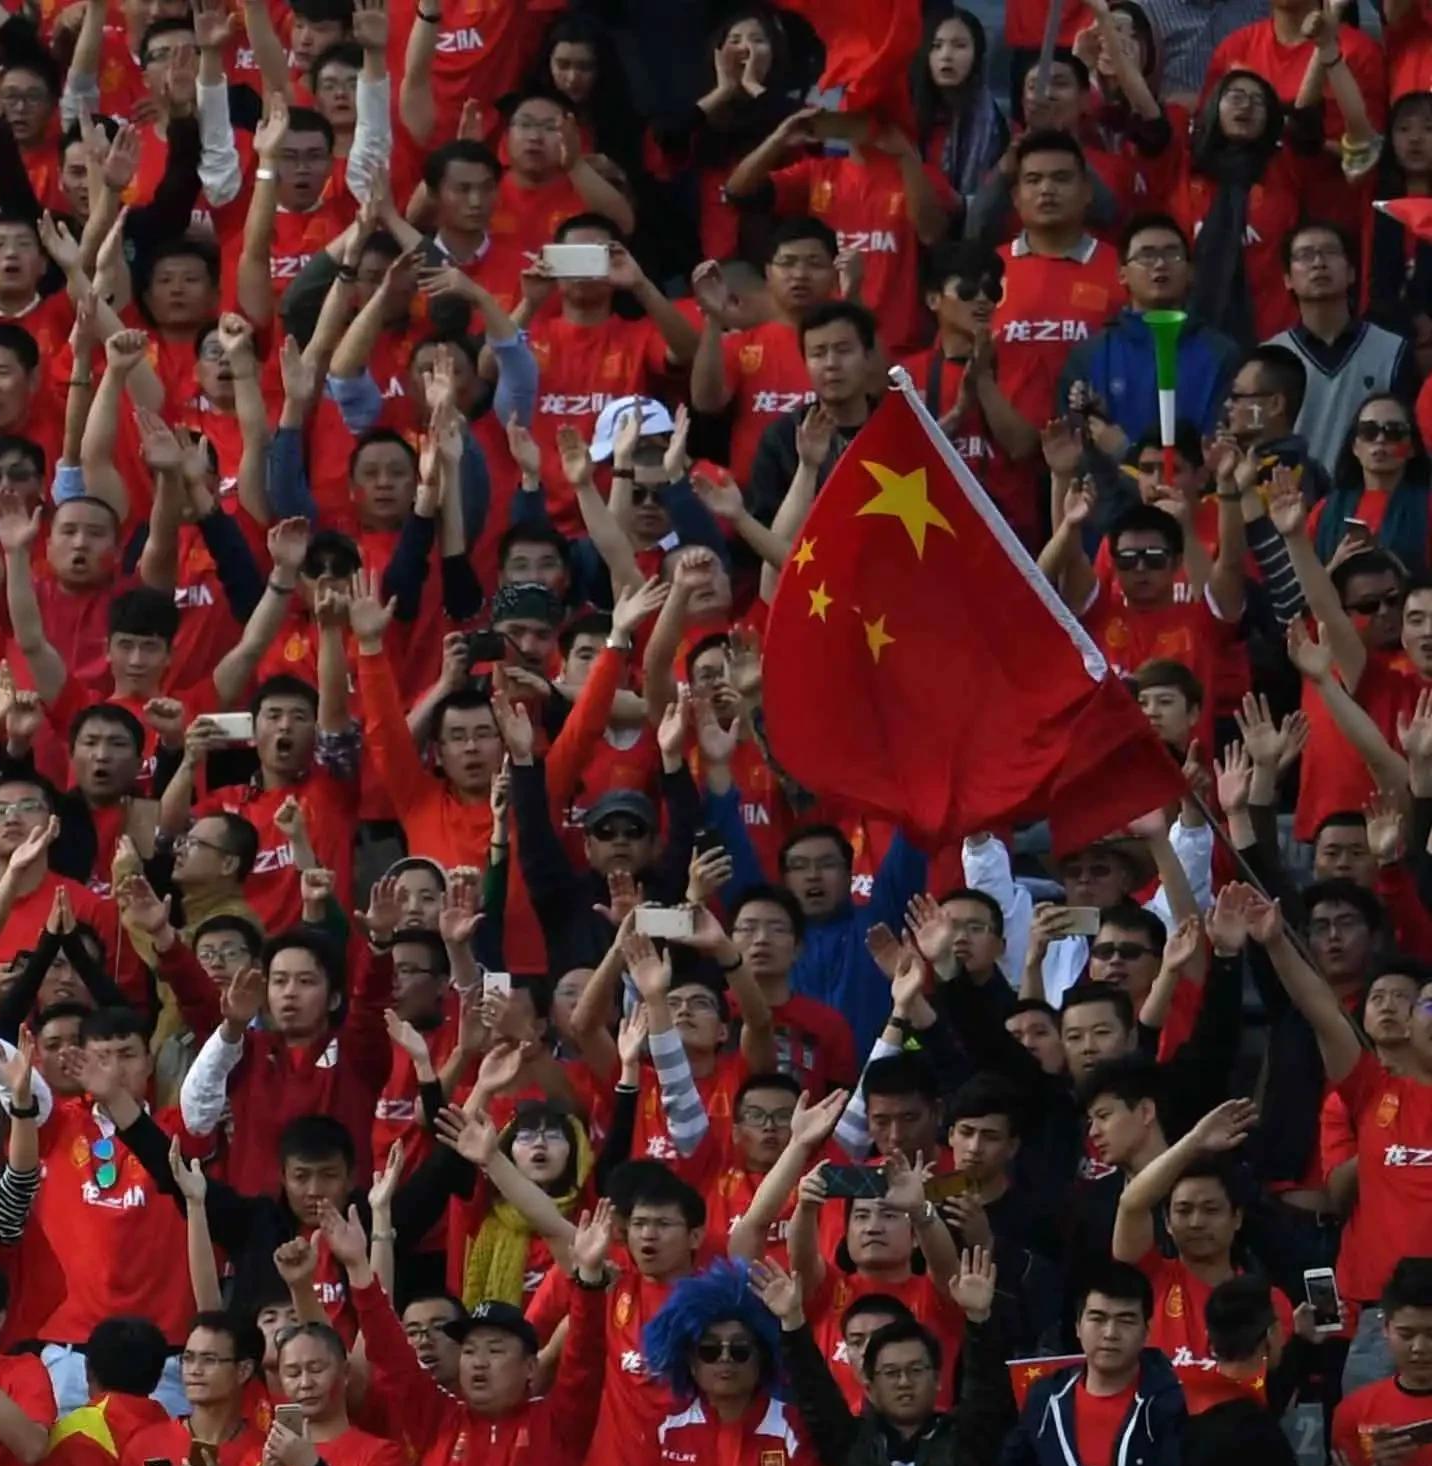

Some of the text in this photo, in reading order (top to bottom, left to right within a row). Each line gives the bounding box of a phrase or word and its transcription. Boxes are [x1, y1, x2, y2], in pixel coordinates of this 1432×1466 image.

[435, 28, 483, 53] 之队
[1004, 320, 1088, 343] 龙之队
[174, 584, 214, 608] 之队
[1384, 1145, 1432, 1166] 龙之
